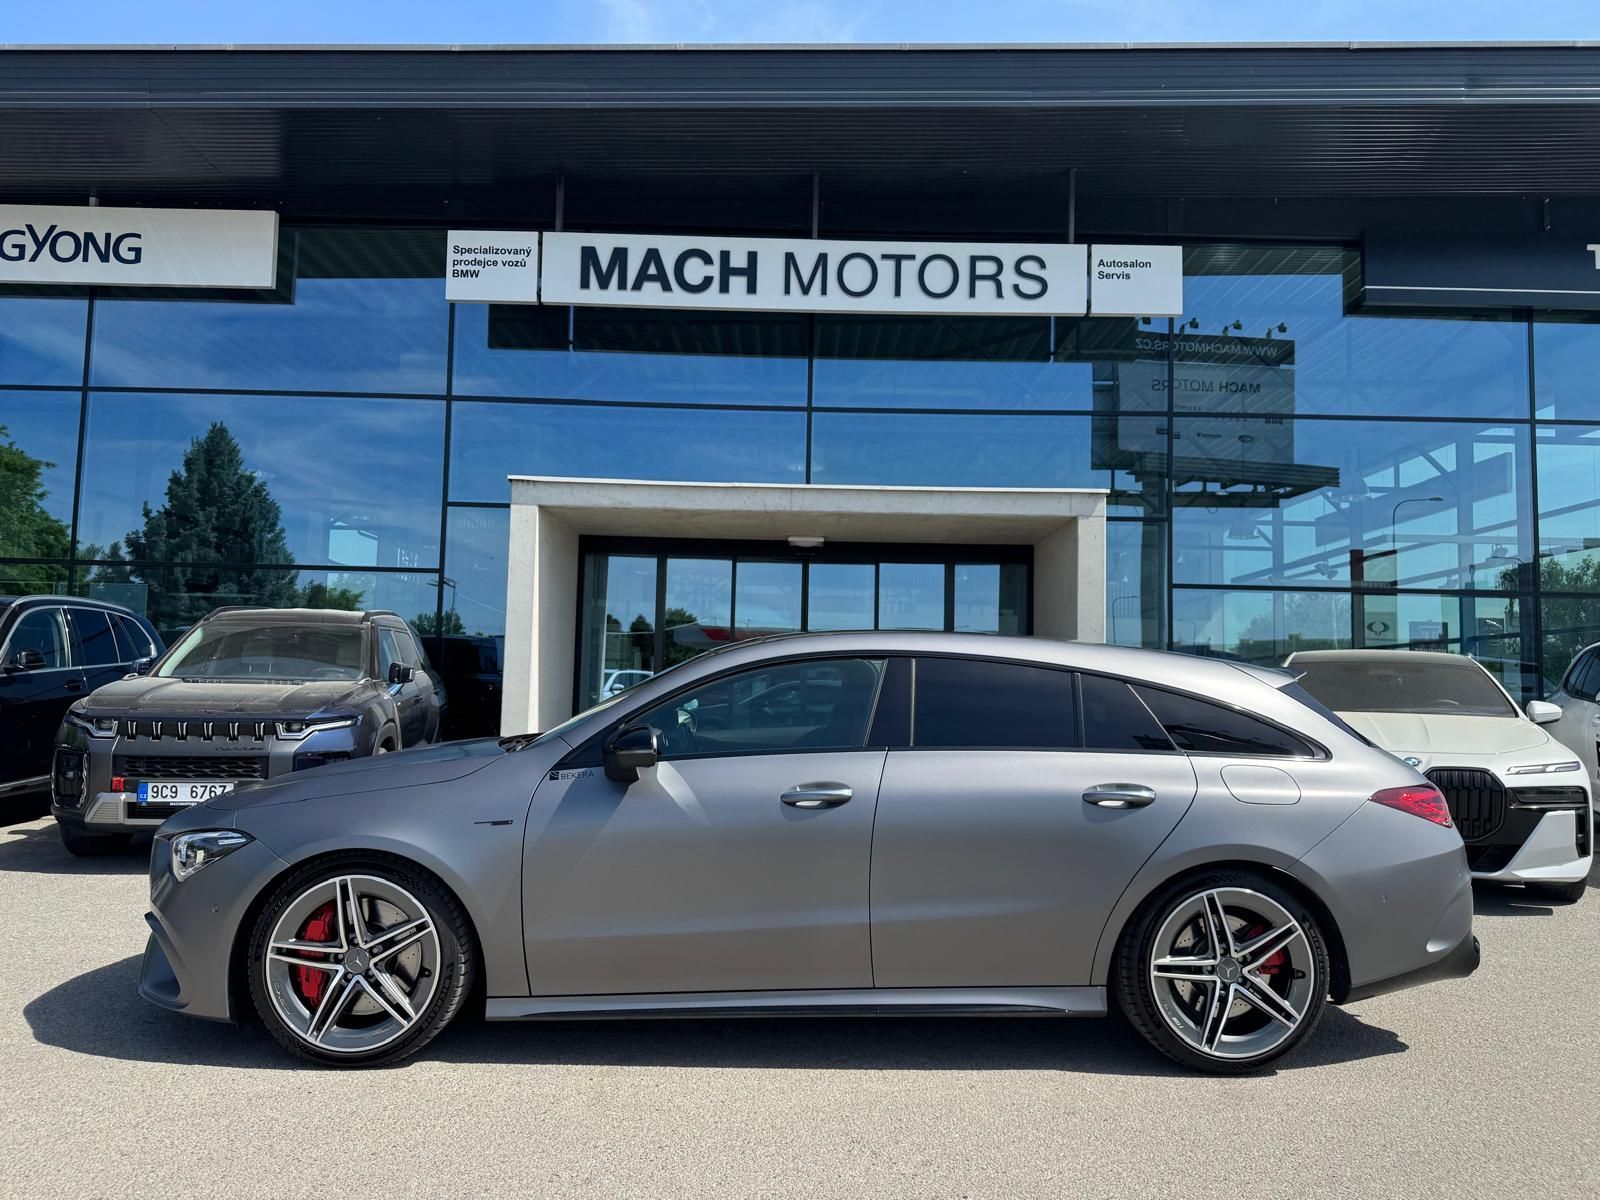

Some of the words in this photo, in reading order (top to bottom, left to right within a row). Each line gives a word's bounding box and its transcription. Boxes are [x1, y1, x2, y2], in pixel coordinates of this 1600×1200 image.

[0, 223, 142, 264] GYONG
[453, 245, 532, 257] Specializovaný
[452, 257, 498, 268] prodejce
[501, 258, 526, 268] vozů
[1097, 259, 1152, 268] Autosalon
[452, 269, 480, 278] BMW
[579, 245, 758, 295] MACH
[783, 251, 1049, 301] MOTORS
[1097, 270, 1131, 280] Servis
[560, 770, 594, 780] BEKERA
[151, 785, 178, 799] 9C9
[190, 785, 227, 799] 6767
